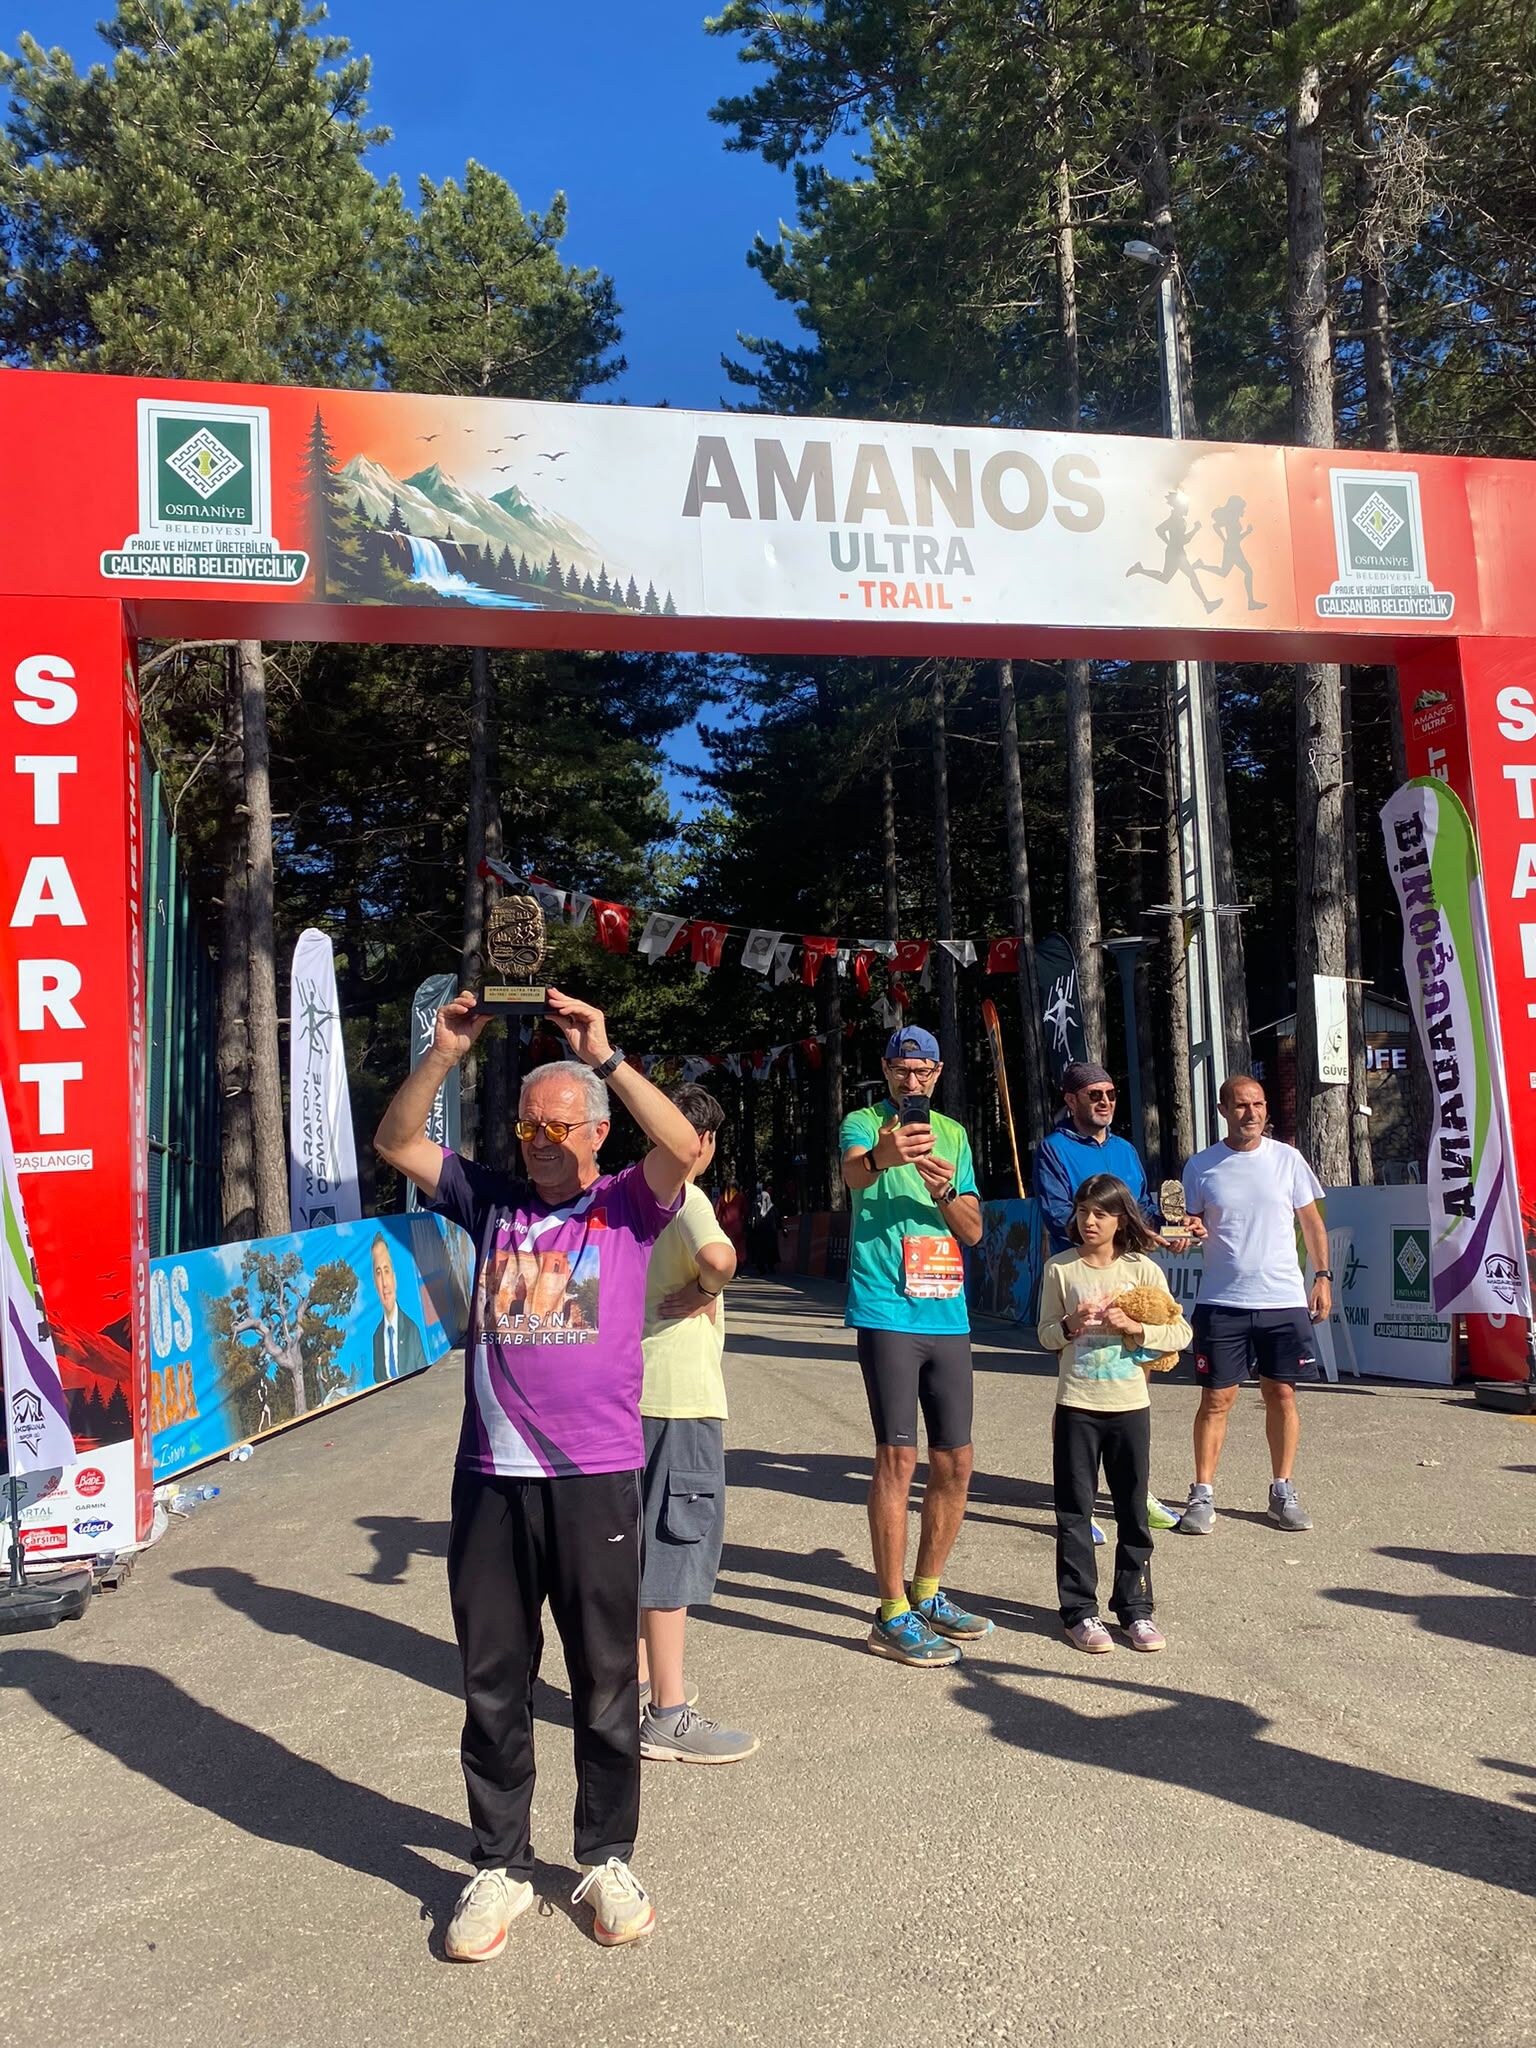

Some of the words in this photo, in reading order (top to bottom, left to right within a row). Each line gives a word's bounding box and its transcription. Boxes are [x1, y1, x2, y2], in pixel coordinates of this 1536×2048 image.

[682, 436, 1106, 533] AMANOS
[165, 503, 246, 519] OSMANİYE
[165, 523, 247, 536] BELEDİYESİ
[131, 540, 161, 551] PROJE
[163, 540, 174, 551] VE
[177, 538, 213, 552] HİZMET
[215, 539, 273, 554] ÜRETEBİLEN
[829, 531, 976, 576] ULTRA
[111, 555, 171, 577] ÇALIŞAN
[173, 552, 197, 576] BİR
[199, 552, 299, 579] BELEDİYECİLİK
[1354, 554, 1409, 567] OSMANİYE
[858, 580, 953, 610] TRAIL
[1365, 596, 1380, 614] BİR
[1381, 595, 1449, 615] BELEDİYECİLİK
[1421, 715, 1447, 732] ULTRA
[128, 730, 138, 893] FETHET
[9, 654, 89, 1135] START
[303, 1079, 315, 1198] MARATON
[313, 1072, 329, 1195] OSMANİYE
[14, 1154, 91, 1171] BAŞLANGIÇ
[934, 1240, 950, 1255] 70
[497, 1311, 564, 1331] AFŞİN
[542, 1331, 588, 1345] KEHF
[18, 1506, 53, 1517] ARTAL
[75, 1502, 106, 1511] GARMIN
[79, 1521, 109, 1534] ideal
